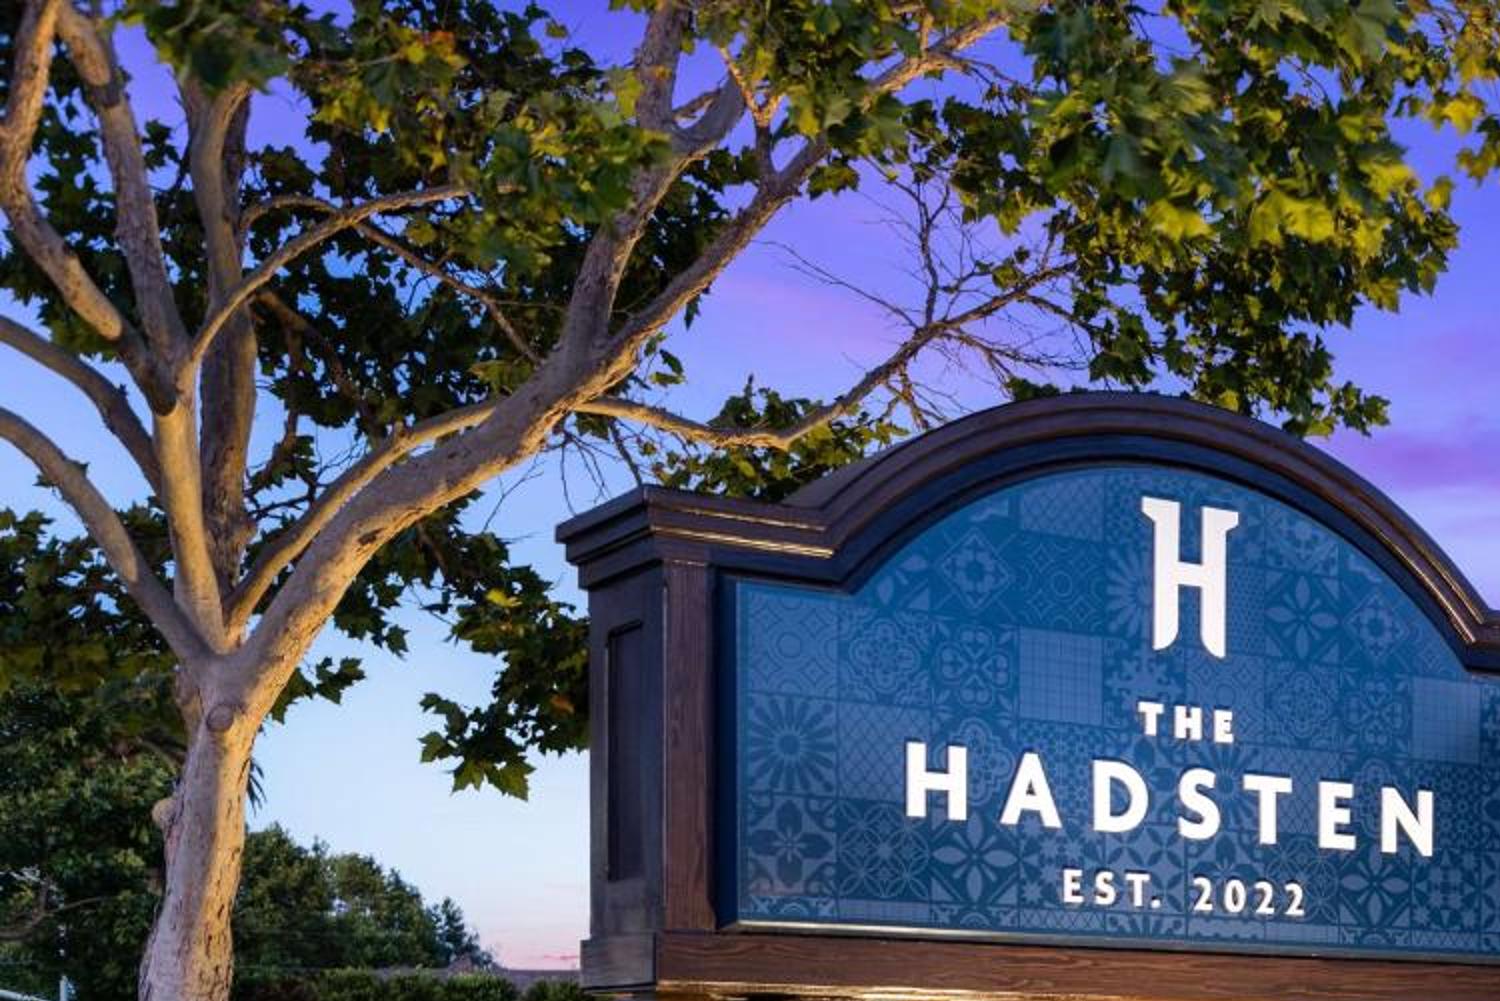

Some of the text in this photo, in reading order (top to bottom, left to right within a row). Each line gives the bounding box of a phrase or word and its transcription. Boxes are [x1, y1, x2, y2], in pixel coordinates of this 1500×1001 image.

[1141, 495, 1240, 659] H
[1137, 700, 1235, 745] THE
[905, 741, 1435, 858] HADSTEN
[1062, 868, 1306, 917] EST. 2022
